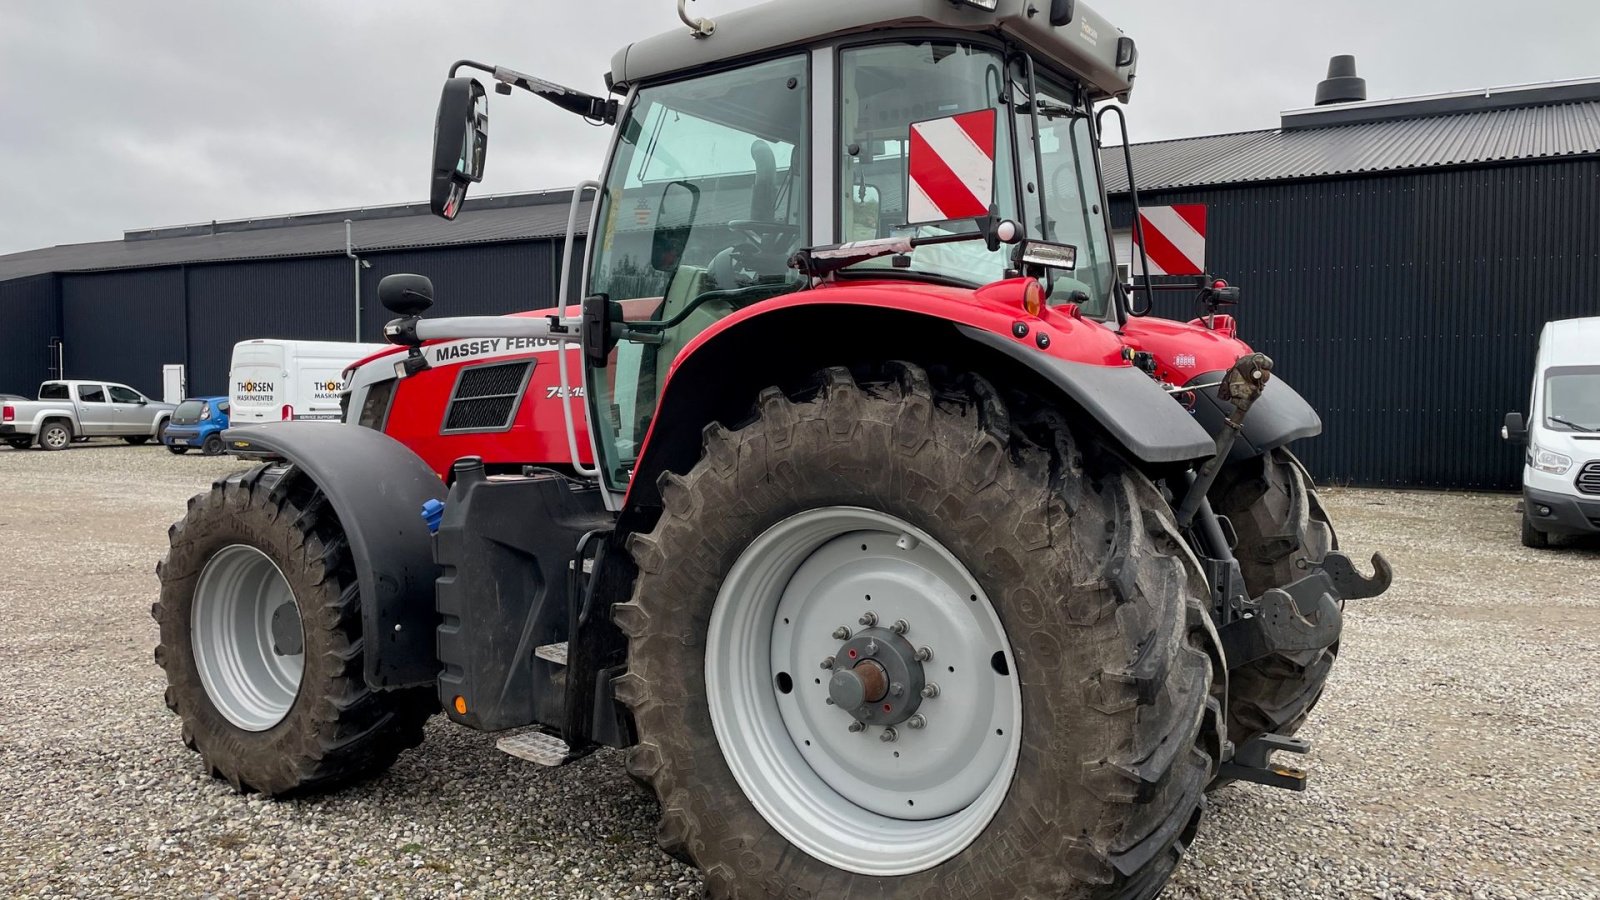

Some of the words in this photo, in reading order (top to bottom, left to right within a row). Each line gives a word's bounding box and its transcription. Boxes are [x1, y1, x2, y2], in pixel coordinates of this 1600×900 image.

[436, 339, 500, 362] MASSEY
[237, 382, 274, 392] THORSEN
[314, 381, 345, 391] THOR
[237, 394, 274, 402] MASKINCENTER
